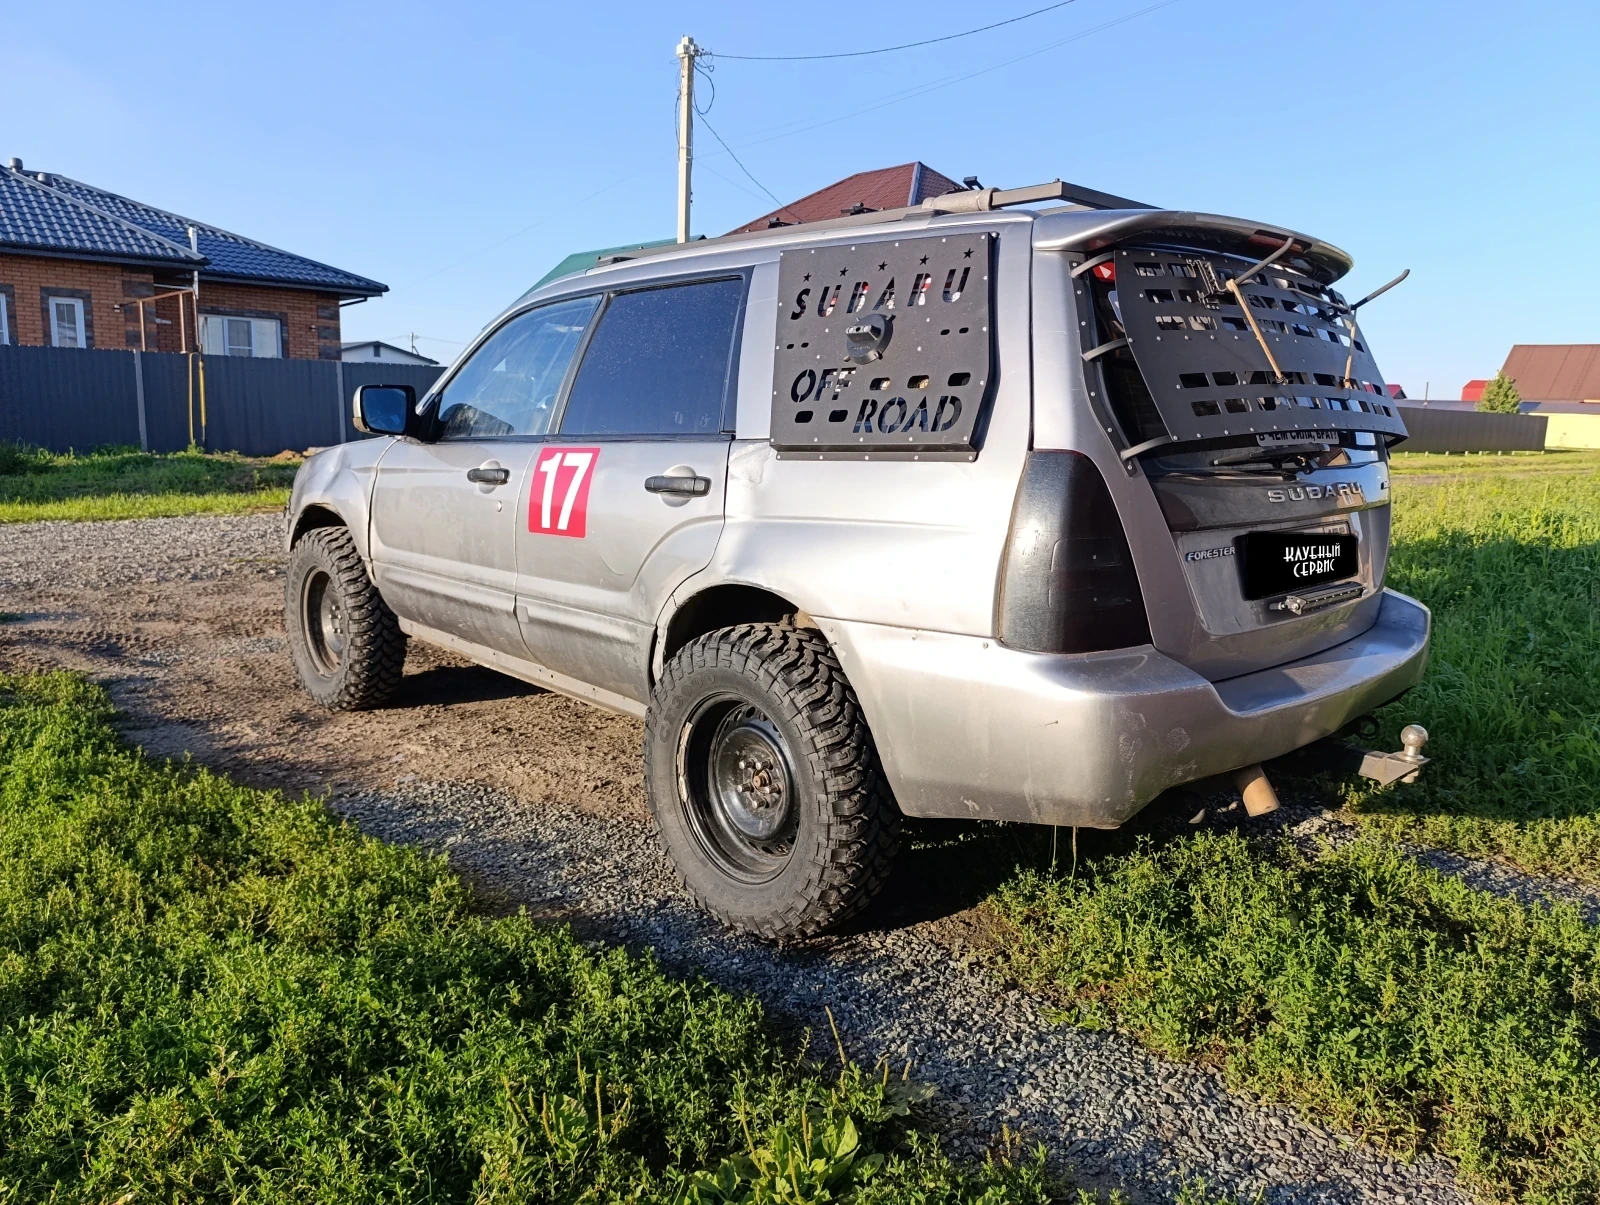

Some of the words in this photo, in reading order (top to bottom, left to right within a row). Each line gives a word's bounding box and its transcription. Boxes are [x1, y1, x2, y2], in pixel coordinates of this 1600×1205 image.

[790, 267, 971, 320] SUBARU
[790, 367, 857, 403] OFF
[852, 395, 963, 434] ROAD
[539, 452, 593, 530] 17
[1267, 482, 1363, 503] SUBARU
[1186, 547, 1236, 561] FORESTER
